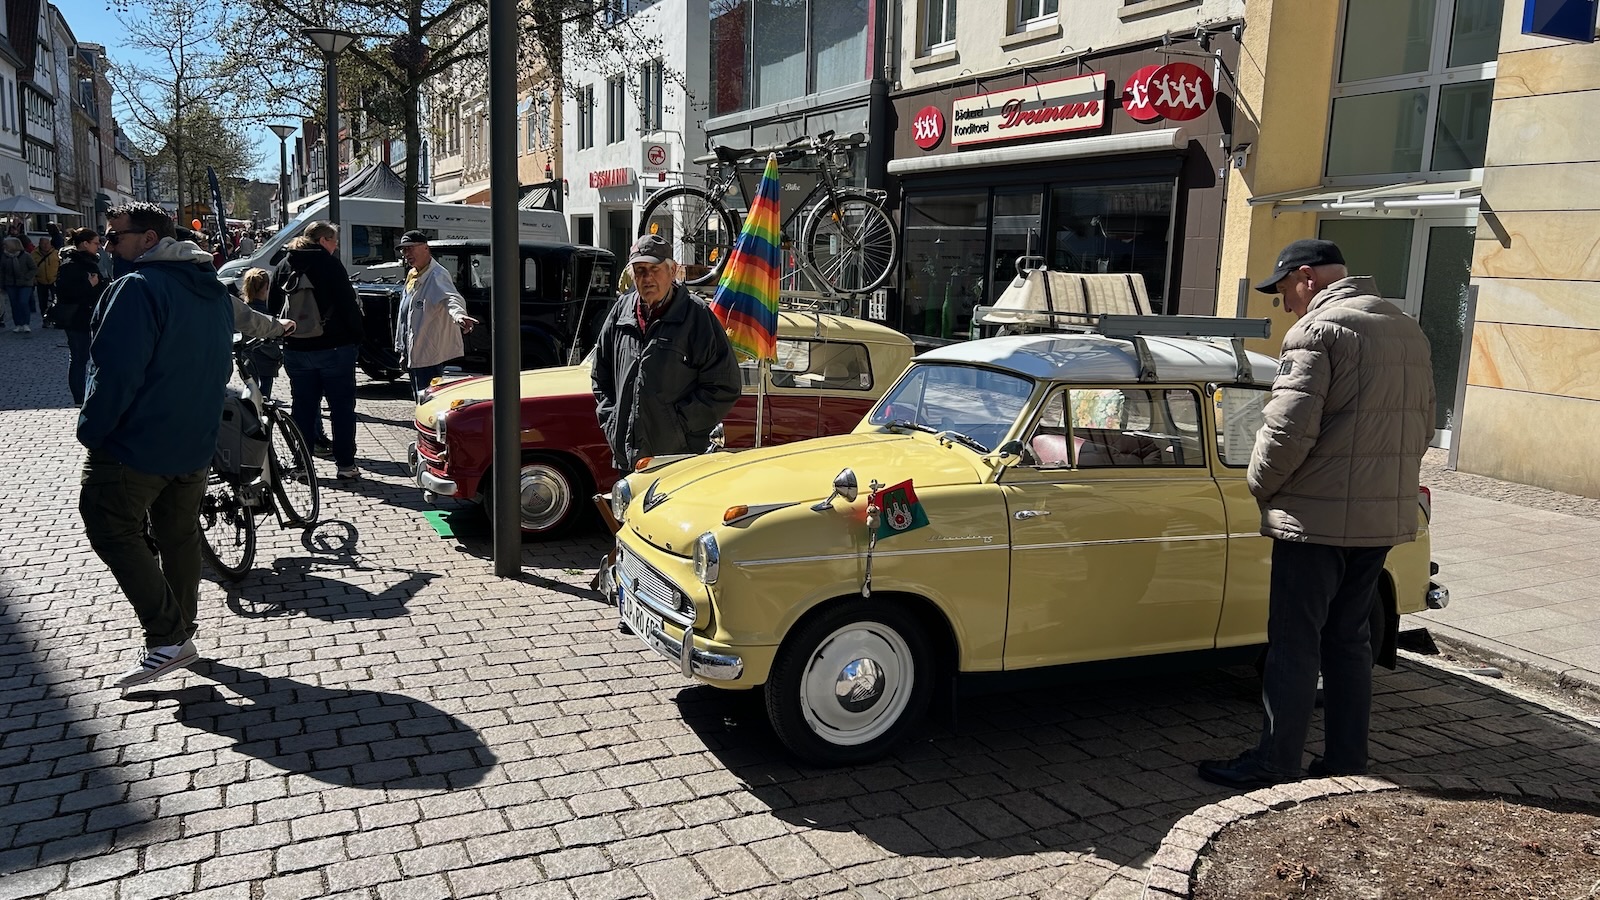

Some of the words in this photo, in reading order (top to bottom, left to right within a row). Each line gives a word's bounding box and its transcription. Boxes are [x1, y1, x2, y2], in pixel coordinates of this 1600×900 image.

[955, 106, 984, 121] Bäckerei
[998, 99, 1099, 129] Dreimann
[954, 121, 989, 137] Konditorei
[1237, 156, 1243, 167] 3
[589, 167, 628, 188] ROSSMANN
